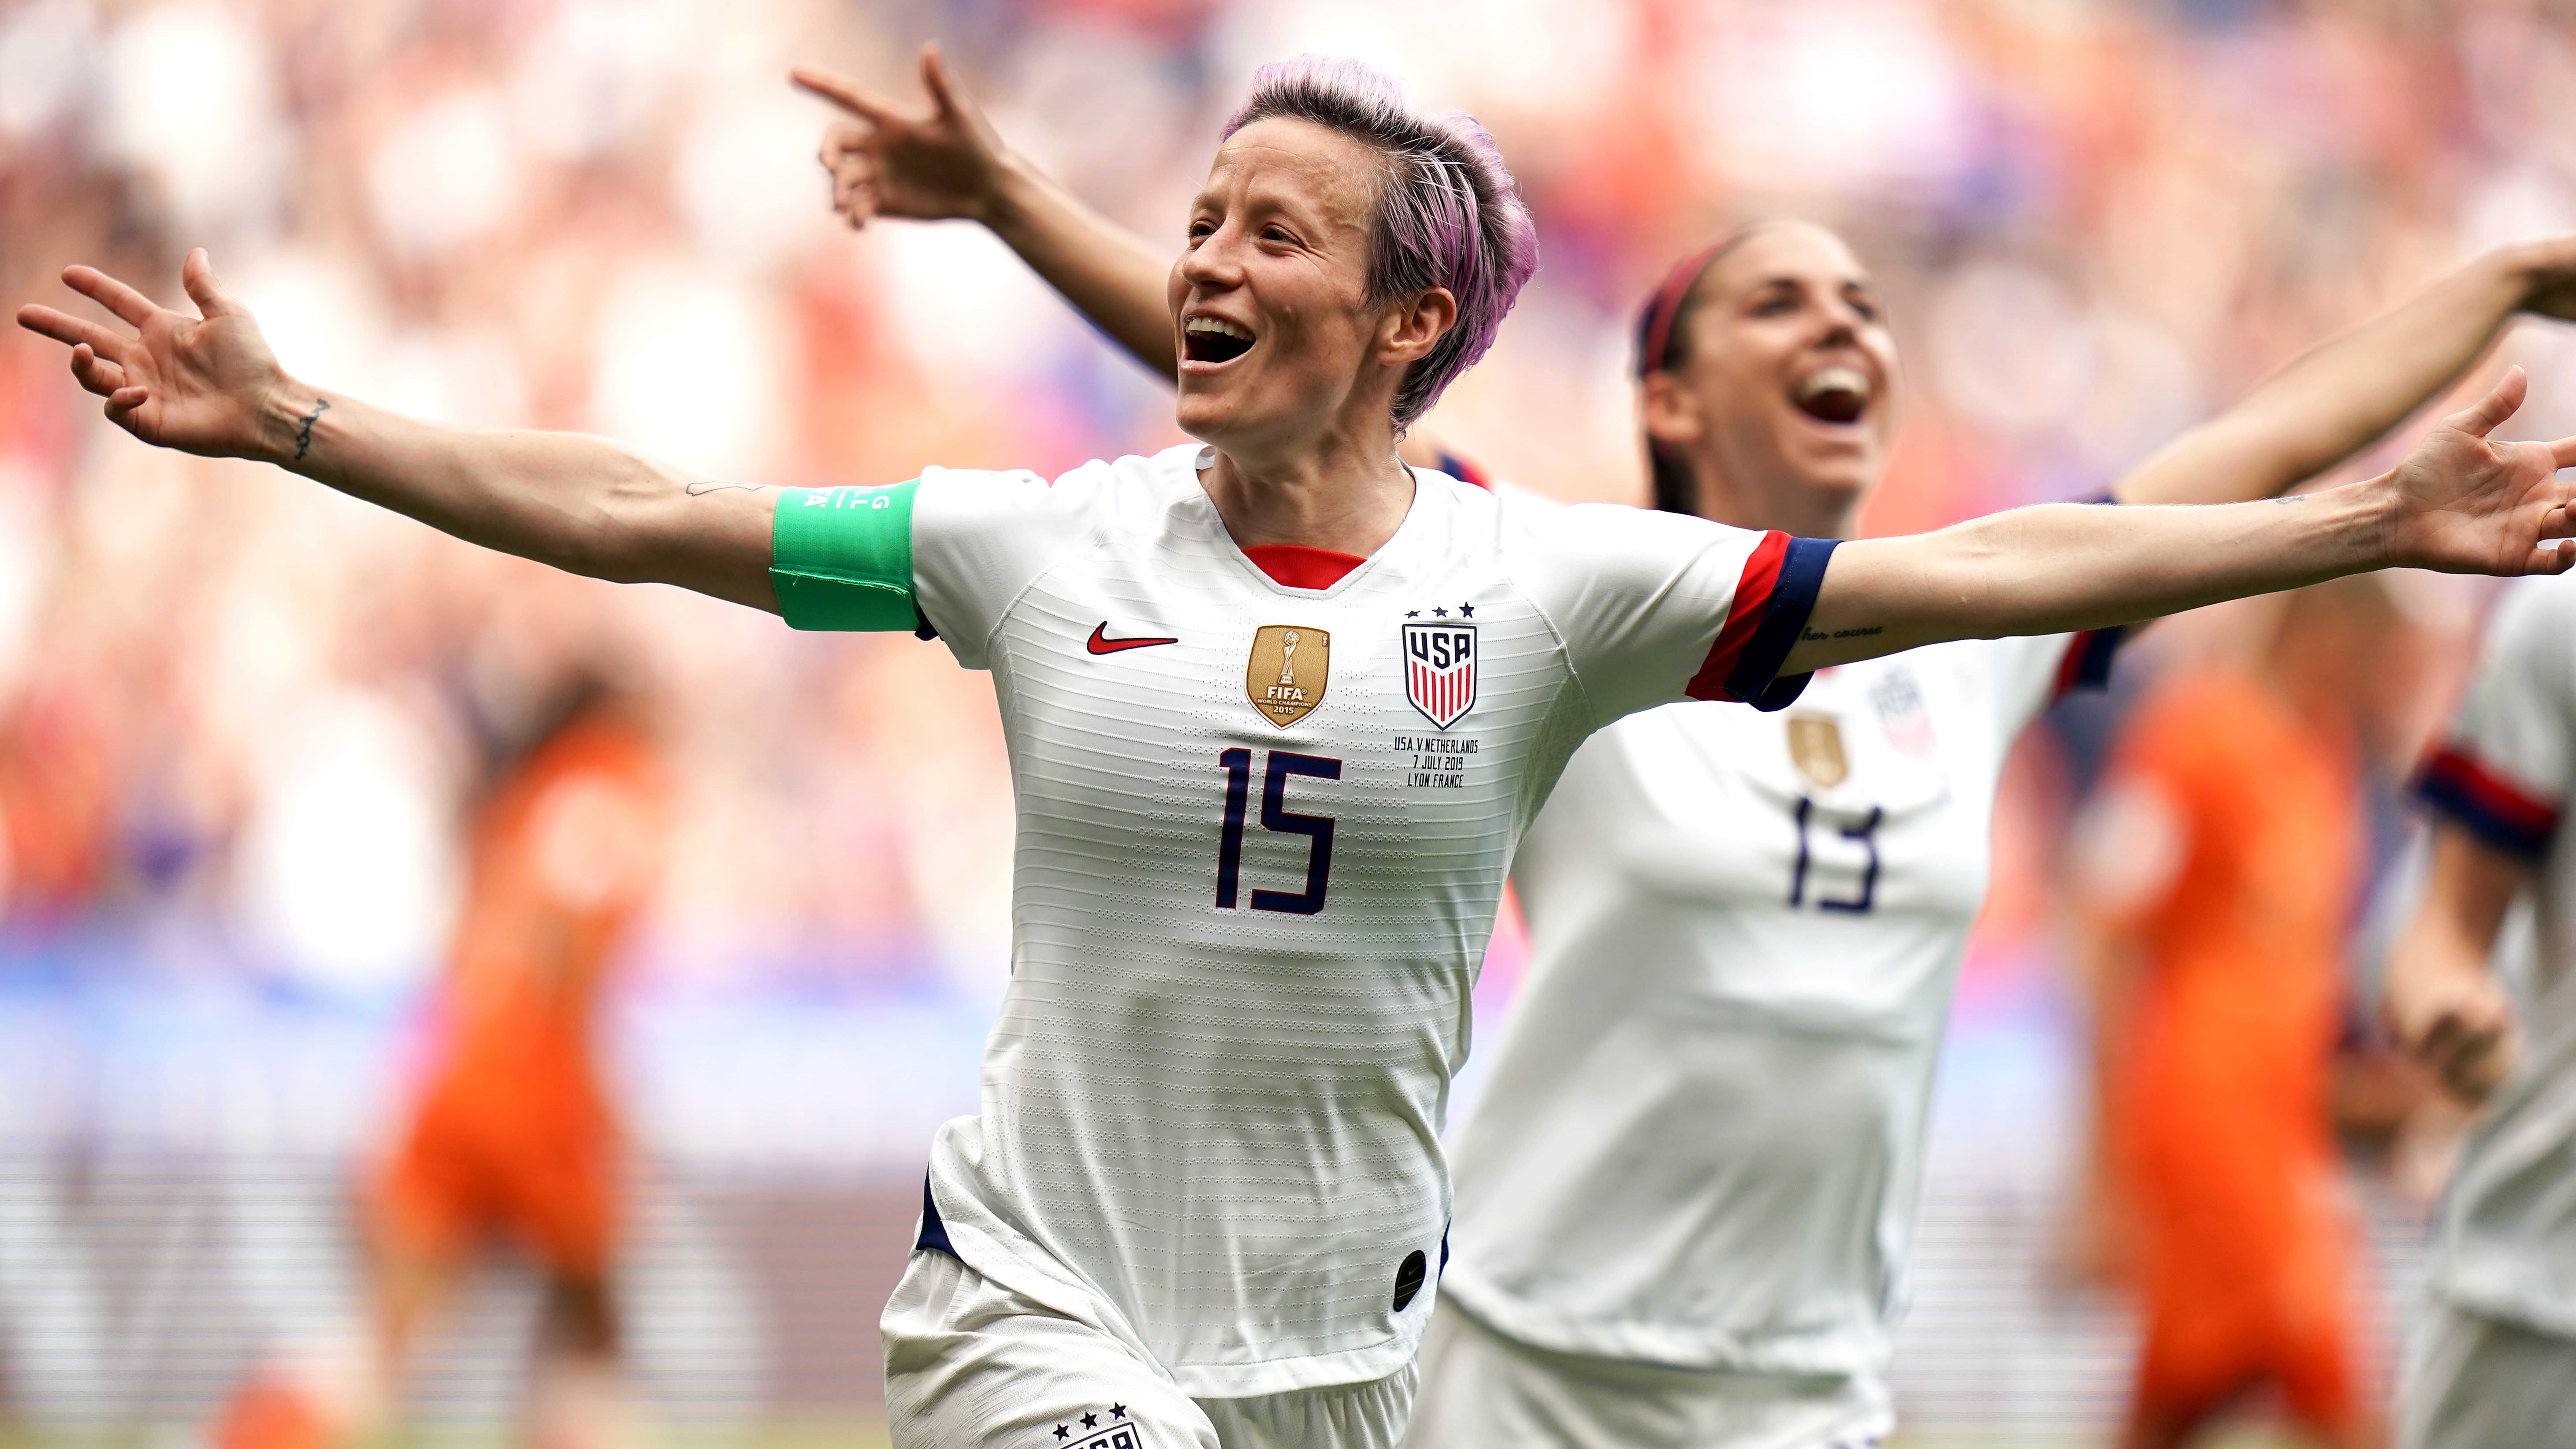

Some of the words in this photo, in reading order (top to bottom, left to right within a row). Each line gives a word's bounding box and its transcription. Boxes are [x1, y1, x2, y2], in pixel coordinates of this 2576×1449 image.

[1801, 626, 1829, 640] her
[1833, 626, 1883, 639] course
[1410, 632, 1470, 669] USA
[1394, 736, 1413, 751] USA
[1417, 737, 1424, 752] V
[1424, 738, 1479, 754] NETHERLANDS
[1413, 755, 1419, 769] 7
[1422, 755, 1442, 770] JULY
[1445, 757, 1464, 771] 2019
[1406, 773, 1430, 788] LYON
[1432, 774, 1464, 788] FRANCE
[1216, 747, 1342, 915] 15
[1788, 795, 1885, 913] 13
